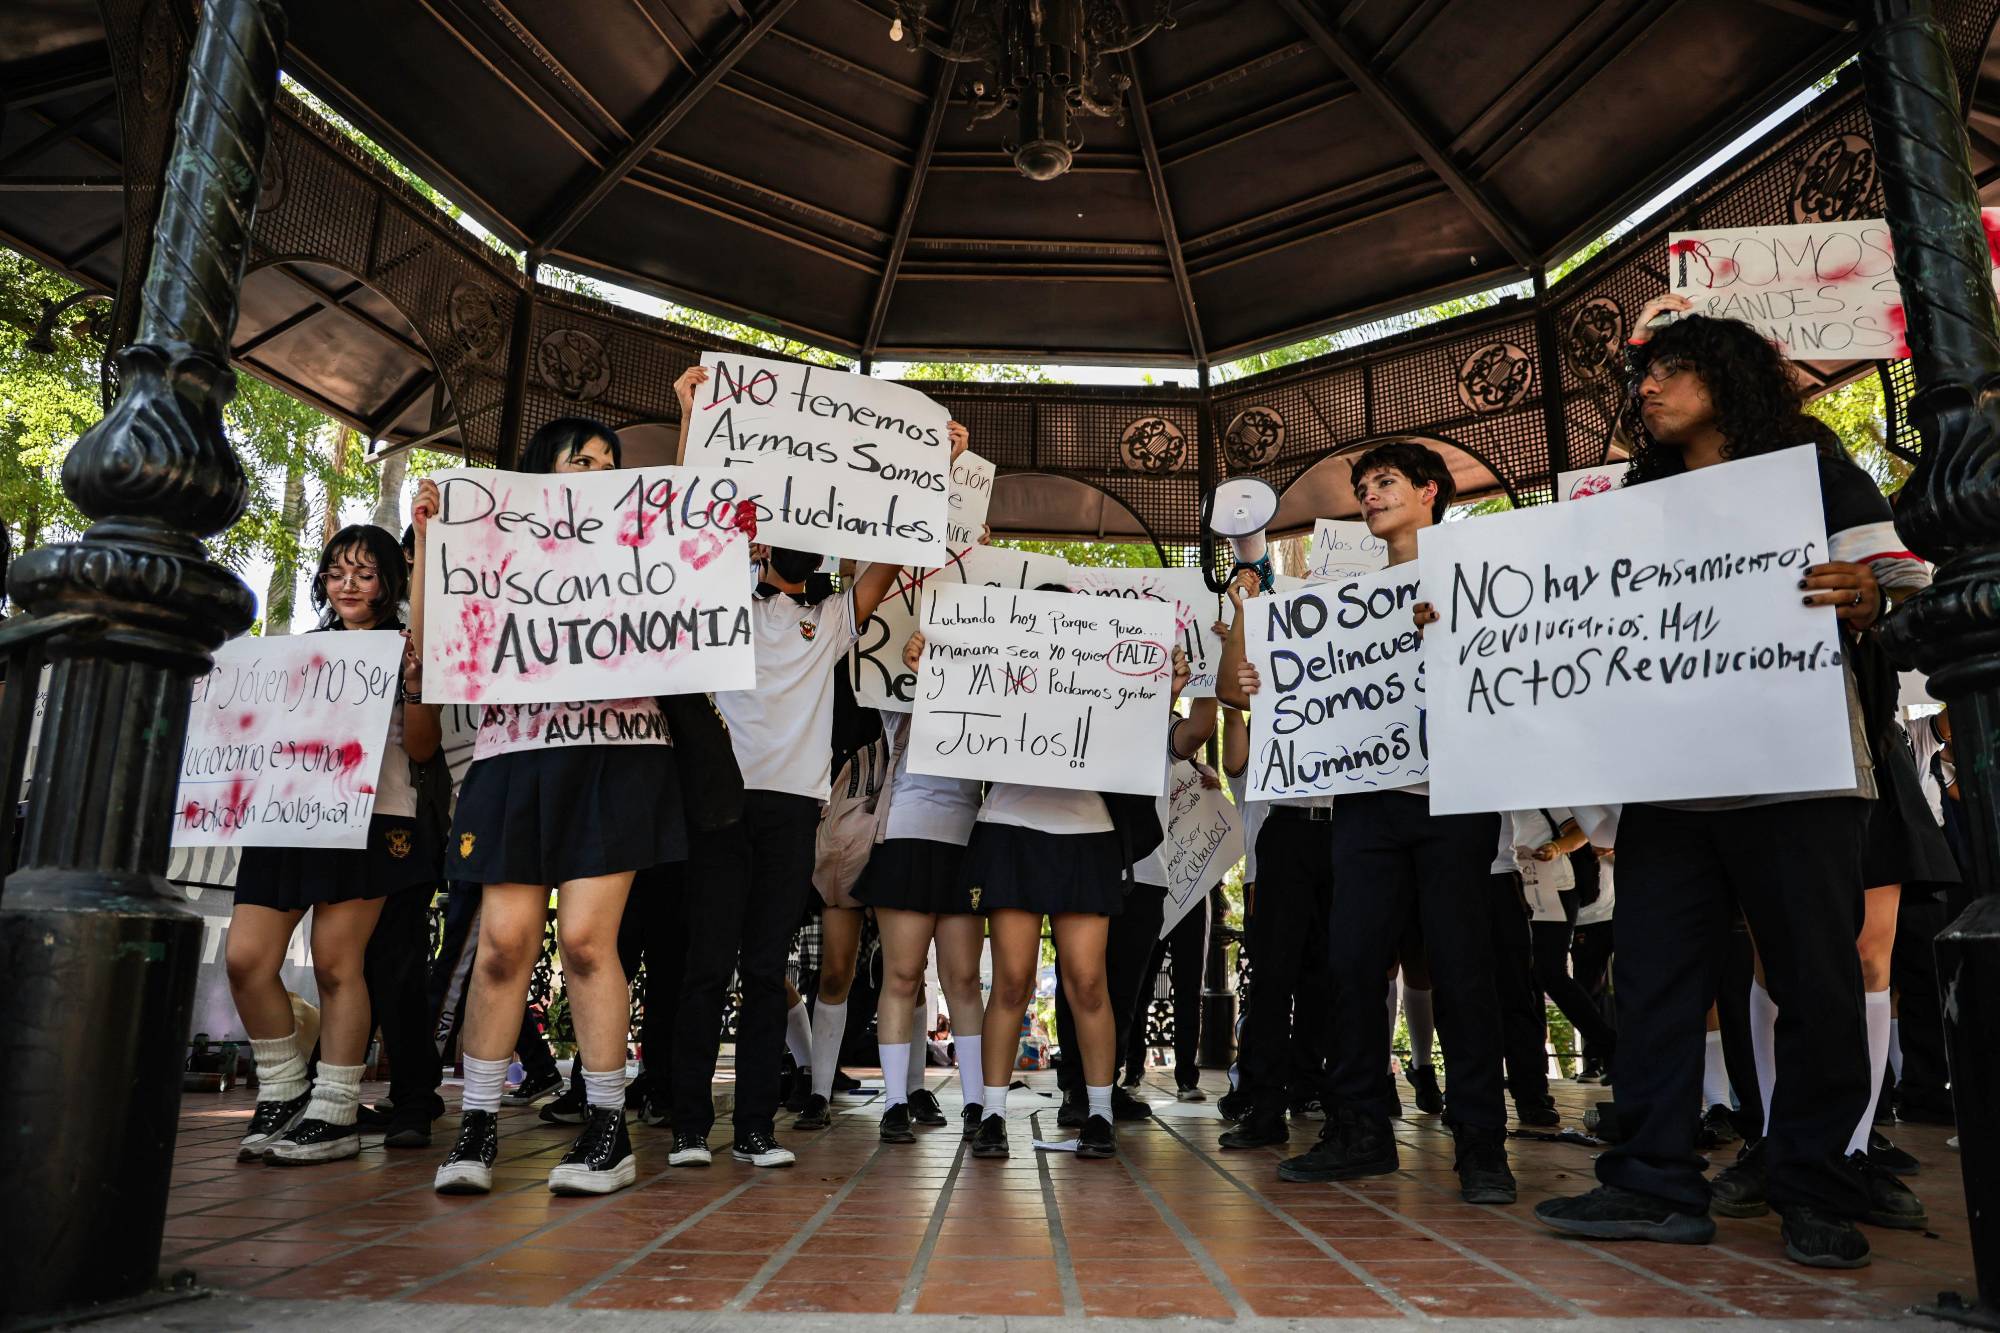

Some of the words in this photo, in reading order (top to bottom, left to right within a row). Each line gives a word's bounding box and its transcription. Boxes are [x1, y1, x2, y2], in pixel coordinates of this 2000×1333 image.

[710, 360, 777, 405] NO
[791, 366, 940, 447] tenemos
[704, 407, 838, 462] Armas
[847, 443, 946, 492] Somos
[438, 477, 604, 545] Desde
[613, 474, 741, 536] 1968
[724, 456, 942, 543] studiantes.
[441, 543, 676, 606] buscando
[1451, 561, 1534, 633] NO
[1544, 563, 1600, 604] hay
[491, 606, 751, 674] AUTONOMIA
[929, 589, 996, 626] Luchando
[1010, 595, 1045, 635] hoy
[1267, 593, 1328, 642] NO
[1116, 643, 1158, 665] FALTE
[289, 664, 309, 711] y
[968, 663, 996, 696] YA
[1003, 662, 1038, 697] NO
[1114, 686, 1157, 710] gritar
[1272, 672, 1405, 735] Somos
[270, 740, 297, 770] es
[435, 1010, 455, 1042] UAS
